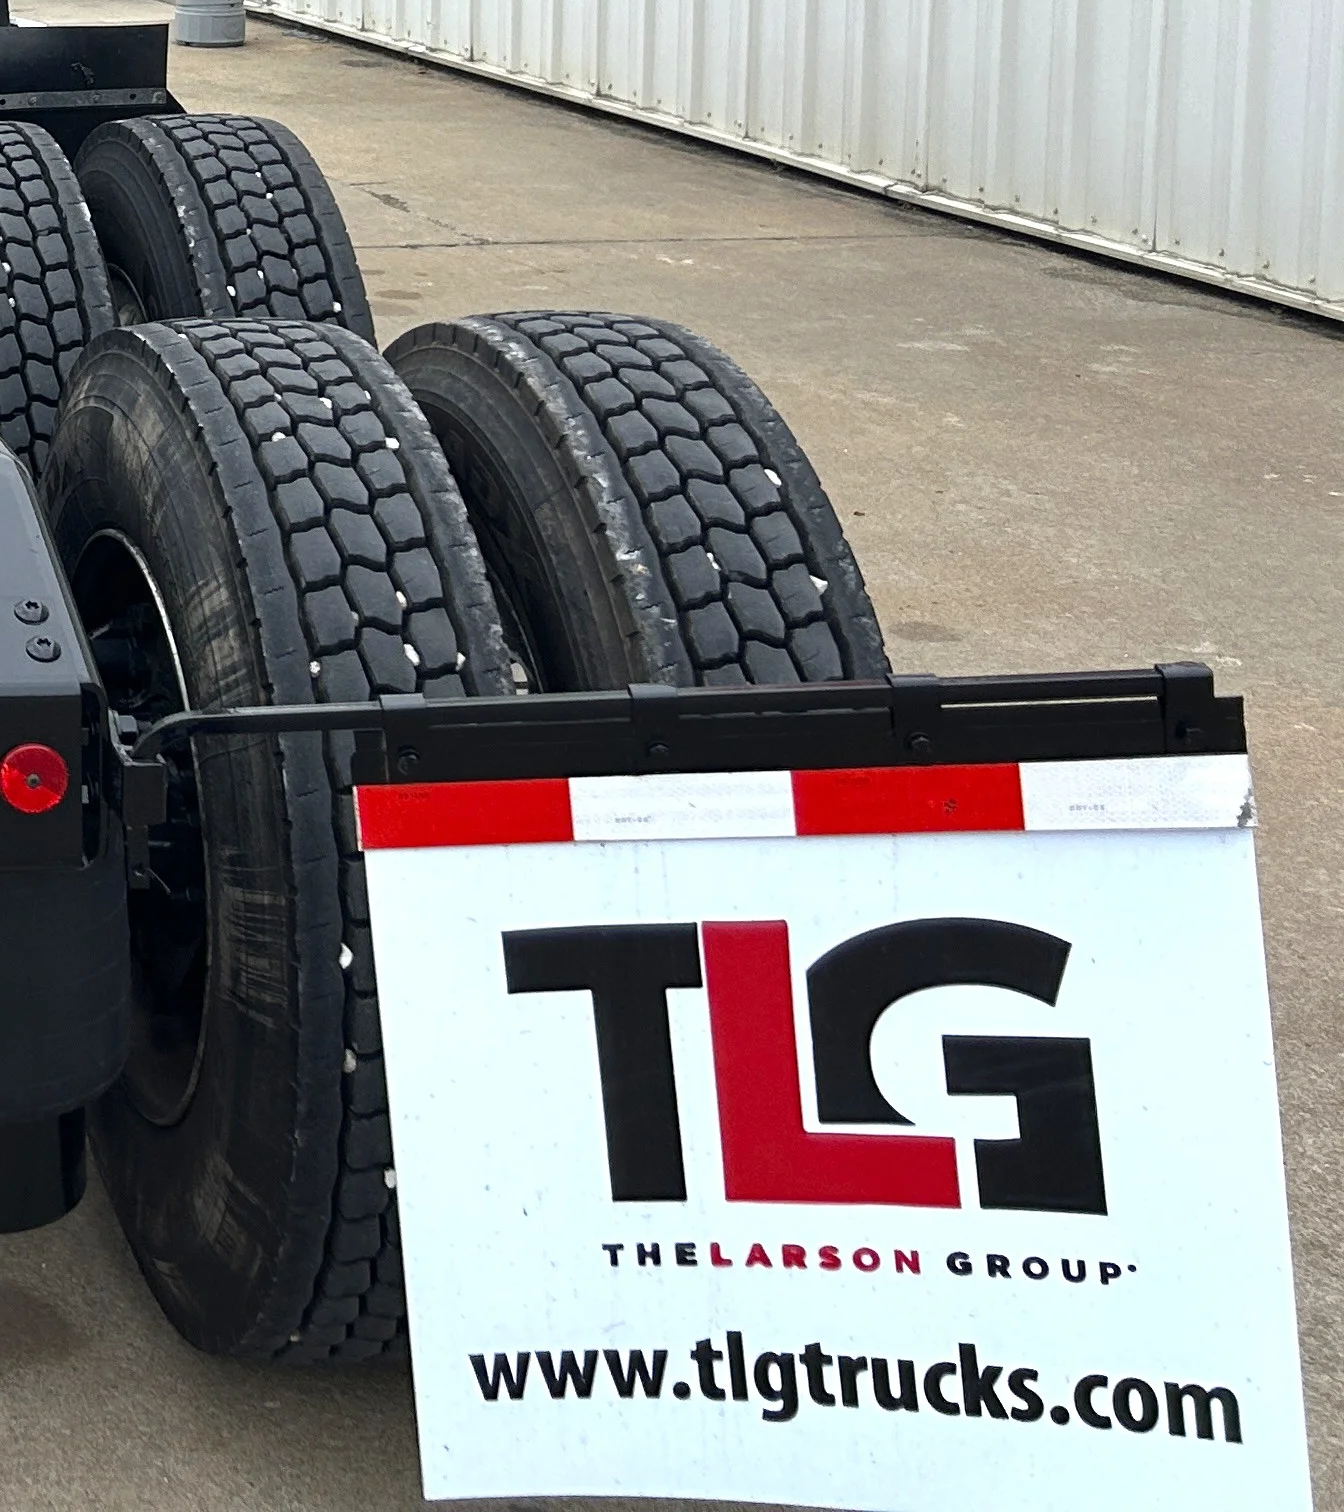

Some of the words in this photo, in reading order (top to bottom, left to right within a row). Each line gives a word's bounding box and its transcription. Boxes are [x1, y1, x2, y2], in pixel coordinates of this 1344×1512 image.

[501, 917, 1108, 1216] TLG
[946, 1251, 1122, 1286] GROUP
[469, 1330, 1243, 1445] www.tlgtrucks.com
